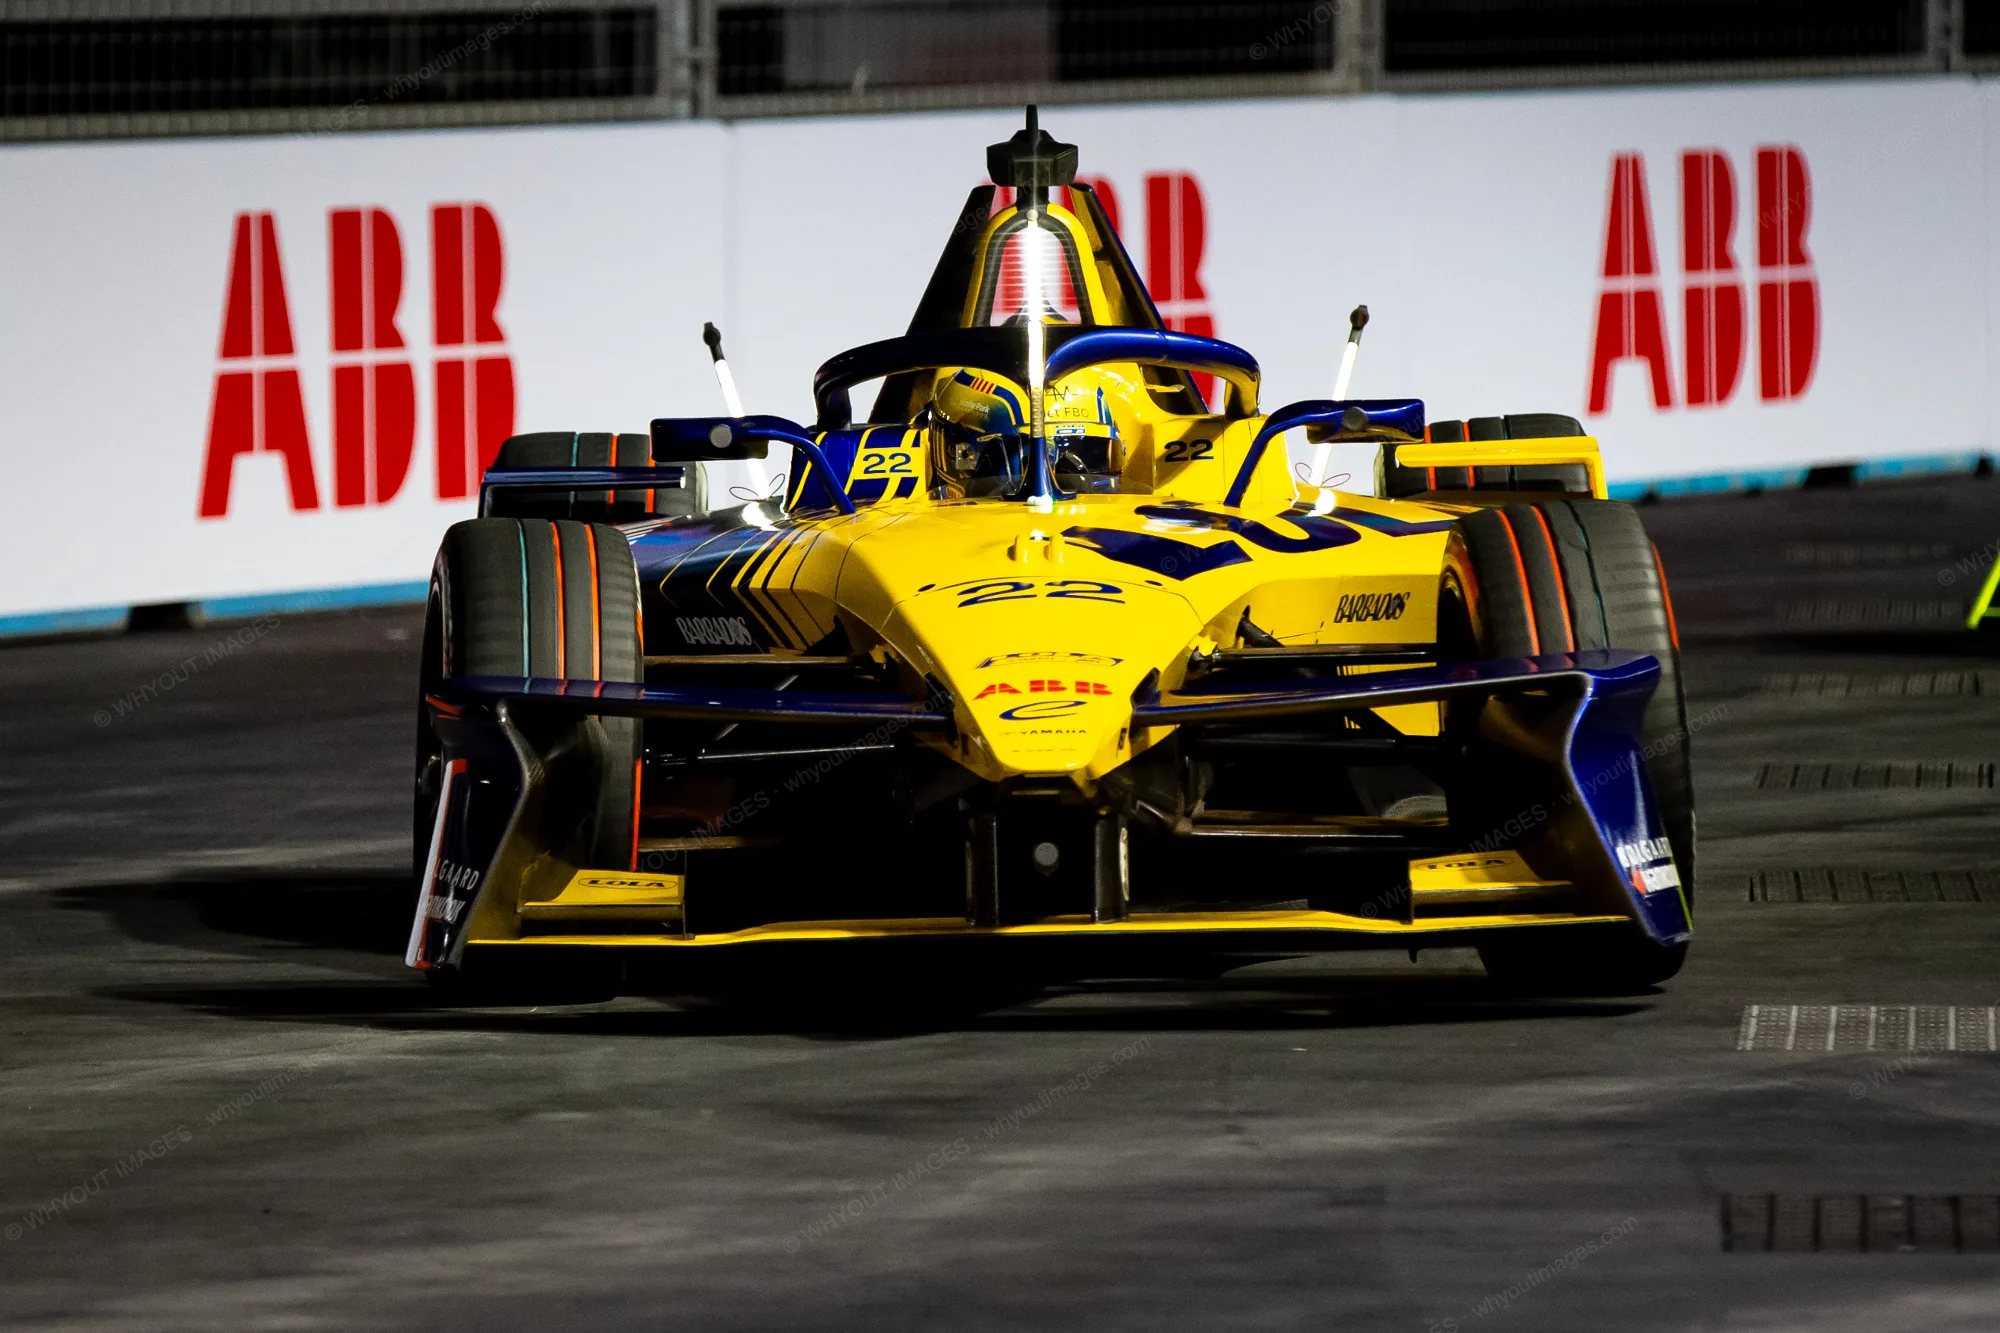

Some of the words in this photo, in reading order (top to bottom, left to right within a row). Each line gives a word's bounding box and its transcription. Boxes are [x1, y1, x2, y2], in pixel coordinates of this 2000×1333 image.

[1586, 146, 1821, 414] ABB
[196, 202, 516, 517] ABB
[863, 452, 912, 474] 22
[1164, 438, 1214, 462] 22
[957, 580, 1126, 608] 22
[972, 679, 1113, 700] ABB
